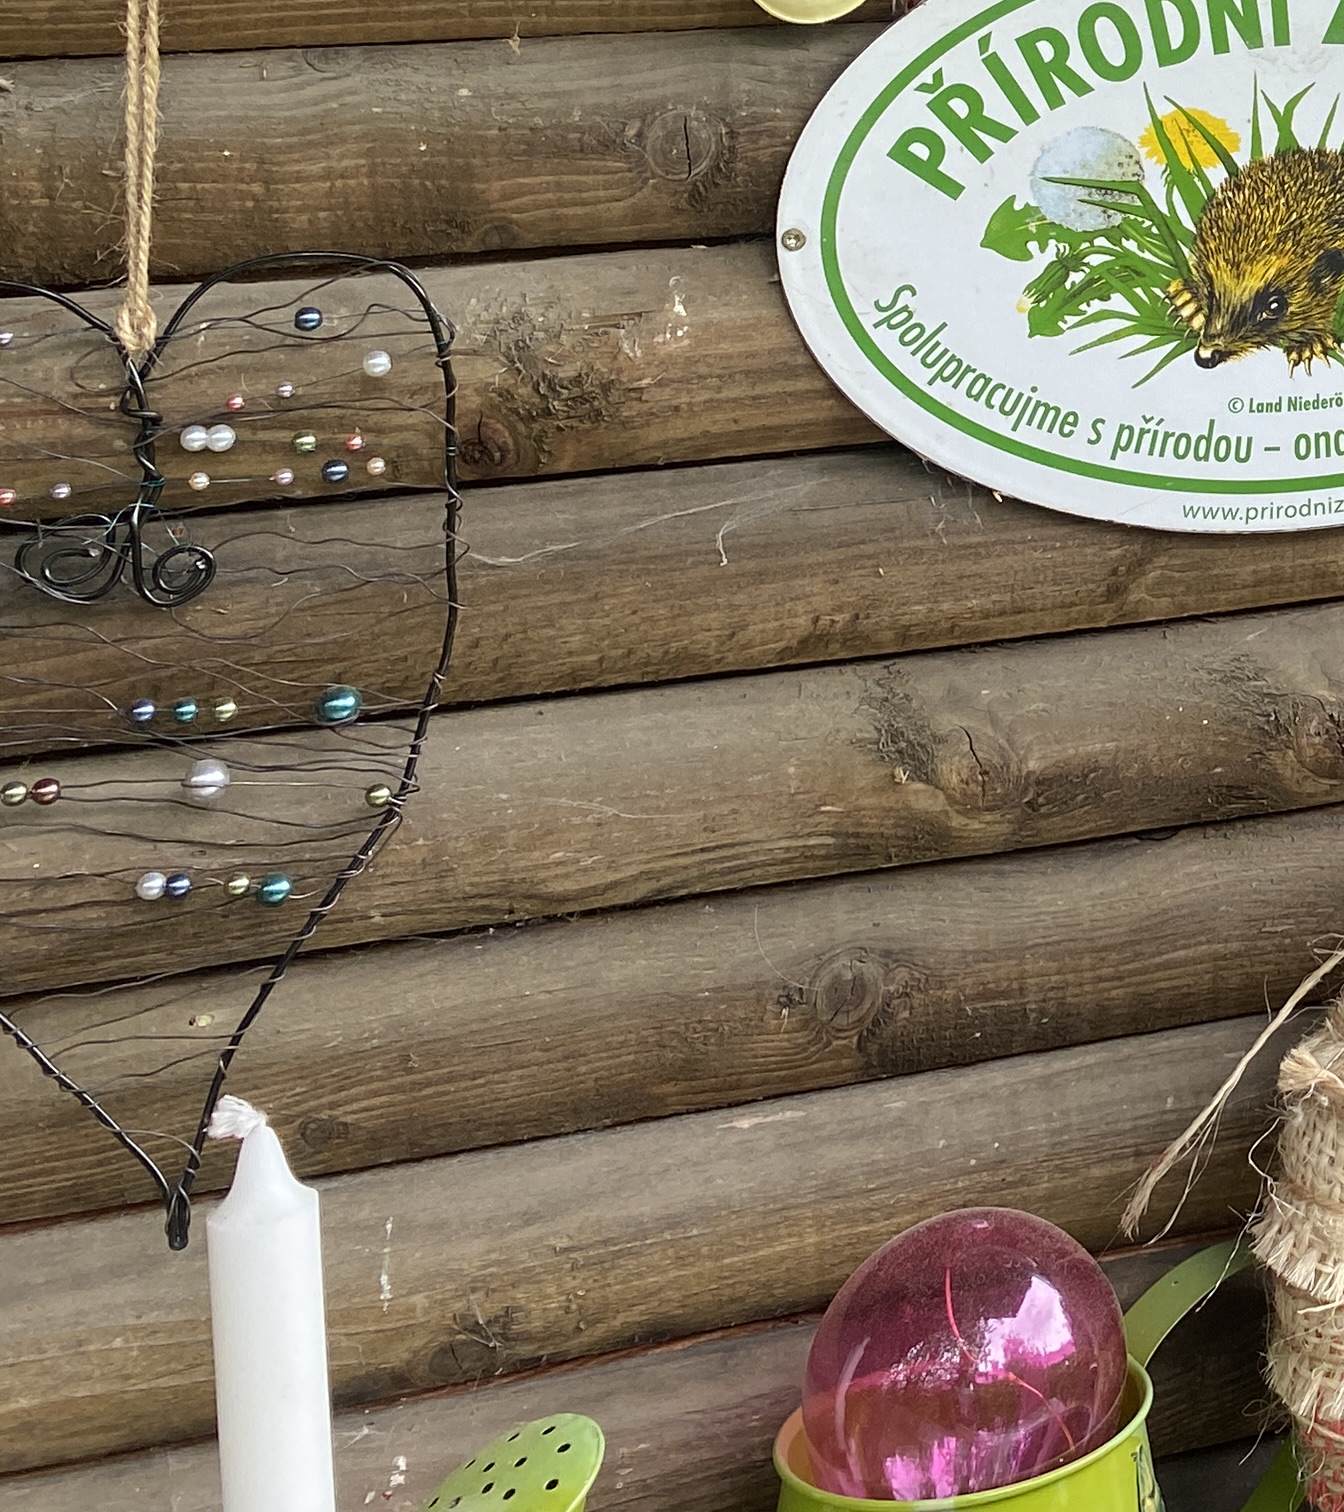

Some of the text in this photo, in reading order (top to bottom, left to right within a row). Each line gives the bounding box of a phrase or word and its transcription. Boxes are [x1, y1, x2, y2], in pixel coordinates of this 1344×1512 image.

[872, 283, 1079, 439] Spolupracujme
[1086, 416, 1108, 446] s
[1111, 414, 1254, 463] přírodou
[1248, 395, 1282, 414] Land
